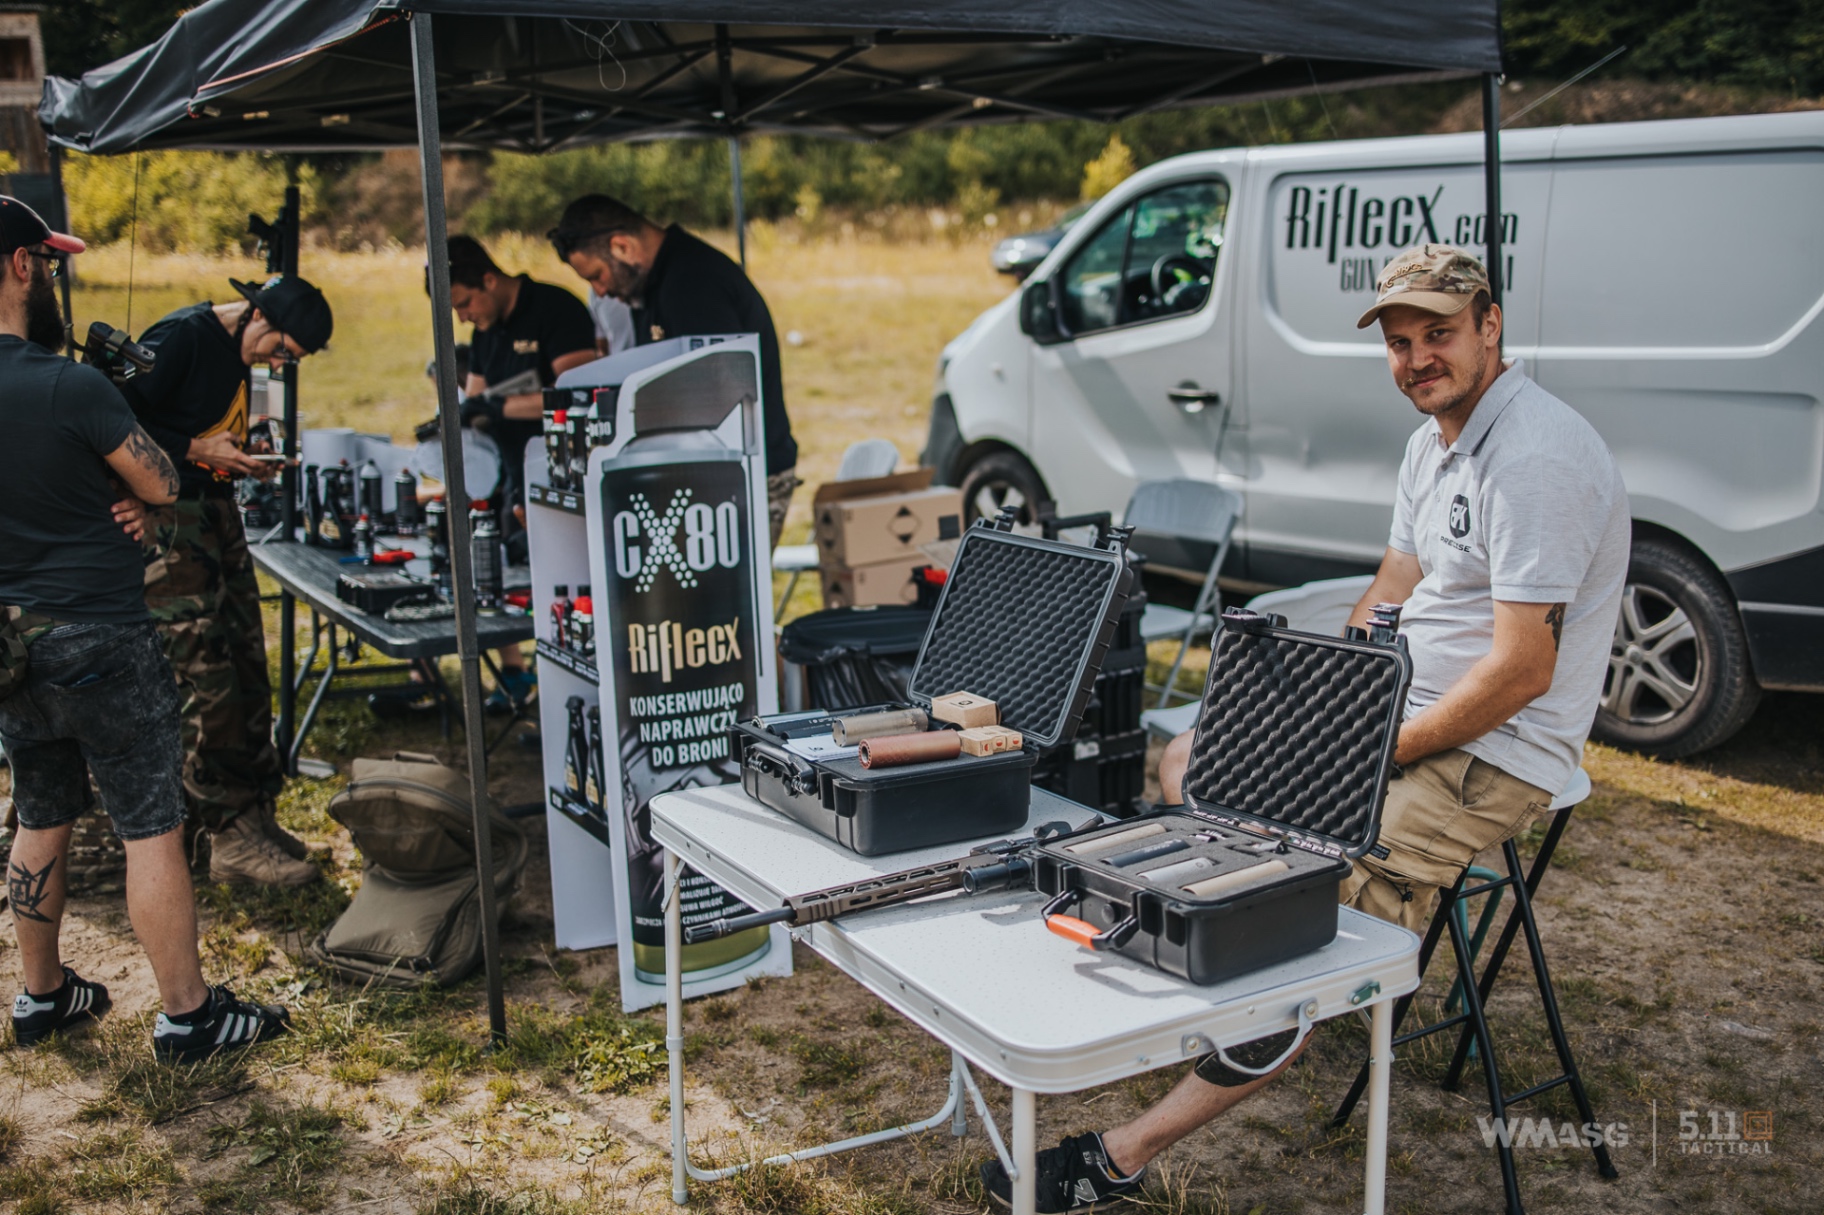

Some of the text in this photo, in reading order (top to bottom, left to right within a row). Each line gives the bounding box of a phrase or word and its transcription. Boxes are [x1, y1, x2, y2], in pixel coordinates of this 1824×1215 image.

[613, 488, 740, 593] CX80
[629, 682, 744, 717] KONSERWUJĄCO
[640, 710, 737, 743] NAPRAWCZY
[652, 736, 729, 767] DO BRONI
[680, 903, 699, 912] SUWA
